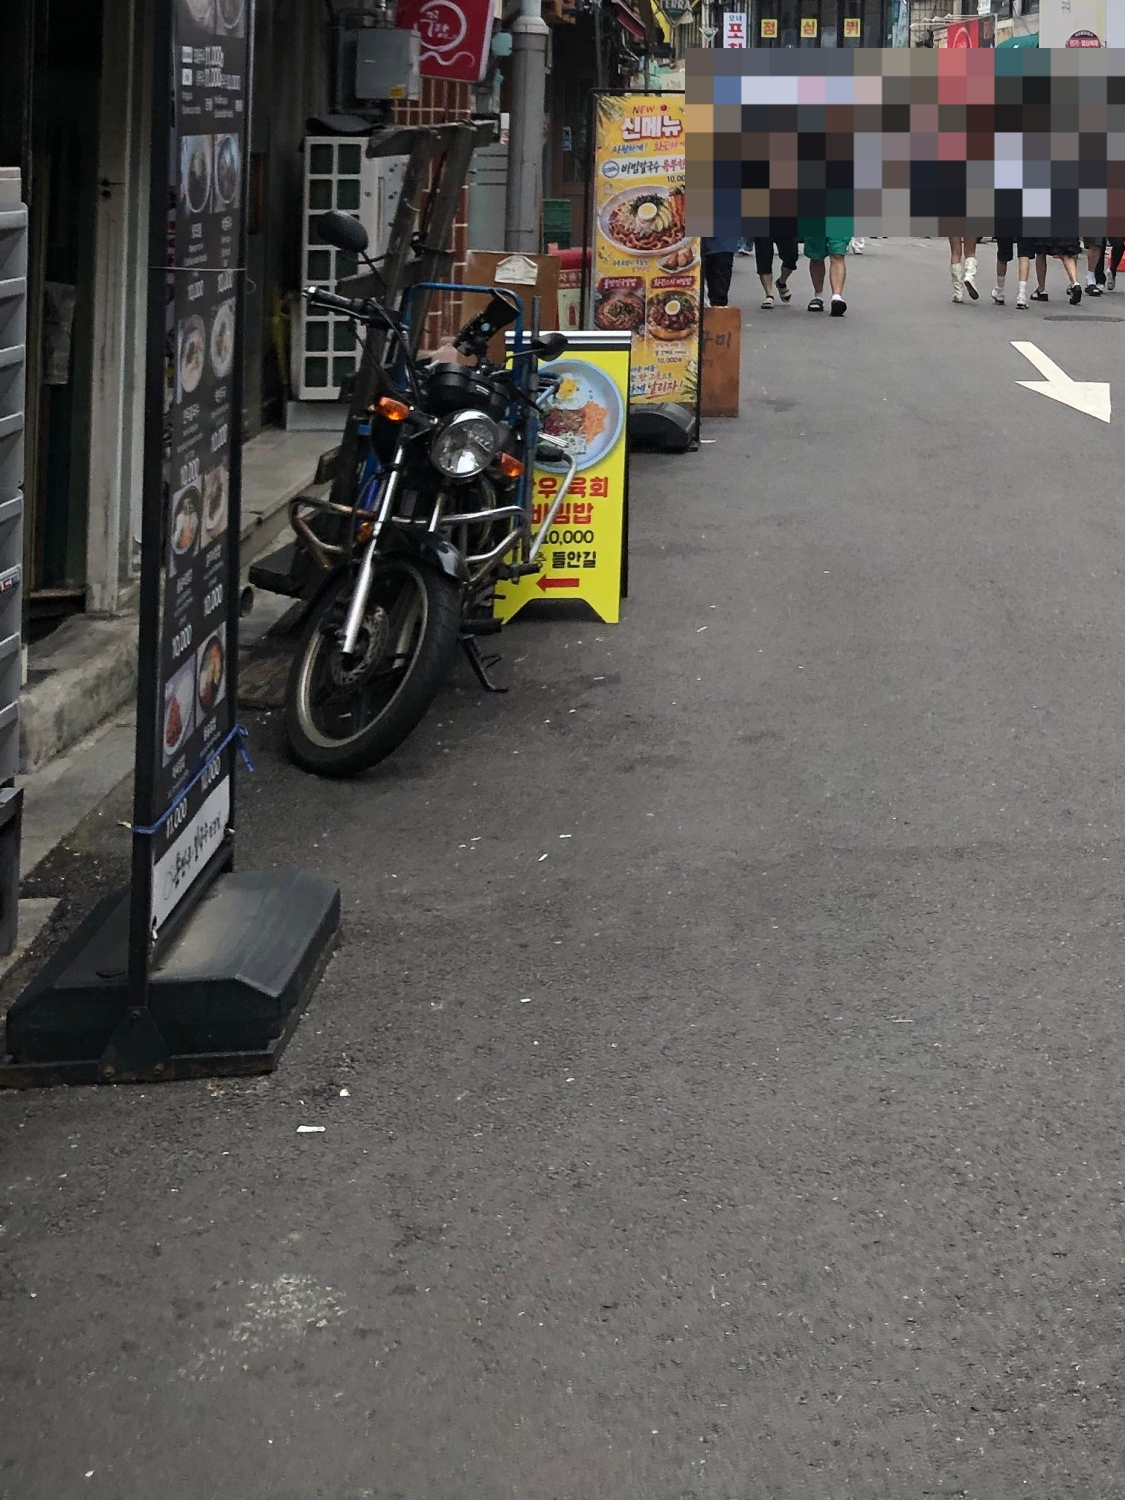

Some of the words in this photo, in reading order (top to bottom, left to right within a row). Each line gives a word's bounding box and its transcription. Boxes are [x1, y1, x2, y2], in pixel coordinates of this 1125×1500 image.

[633, 105, 656, 115] NEW
[621, 115, 684, 142] 신메뉴
[552, 551, 596, 569] 들안길
